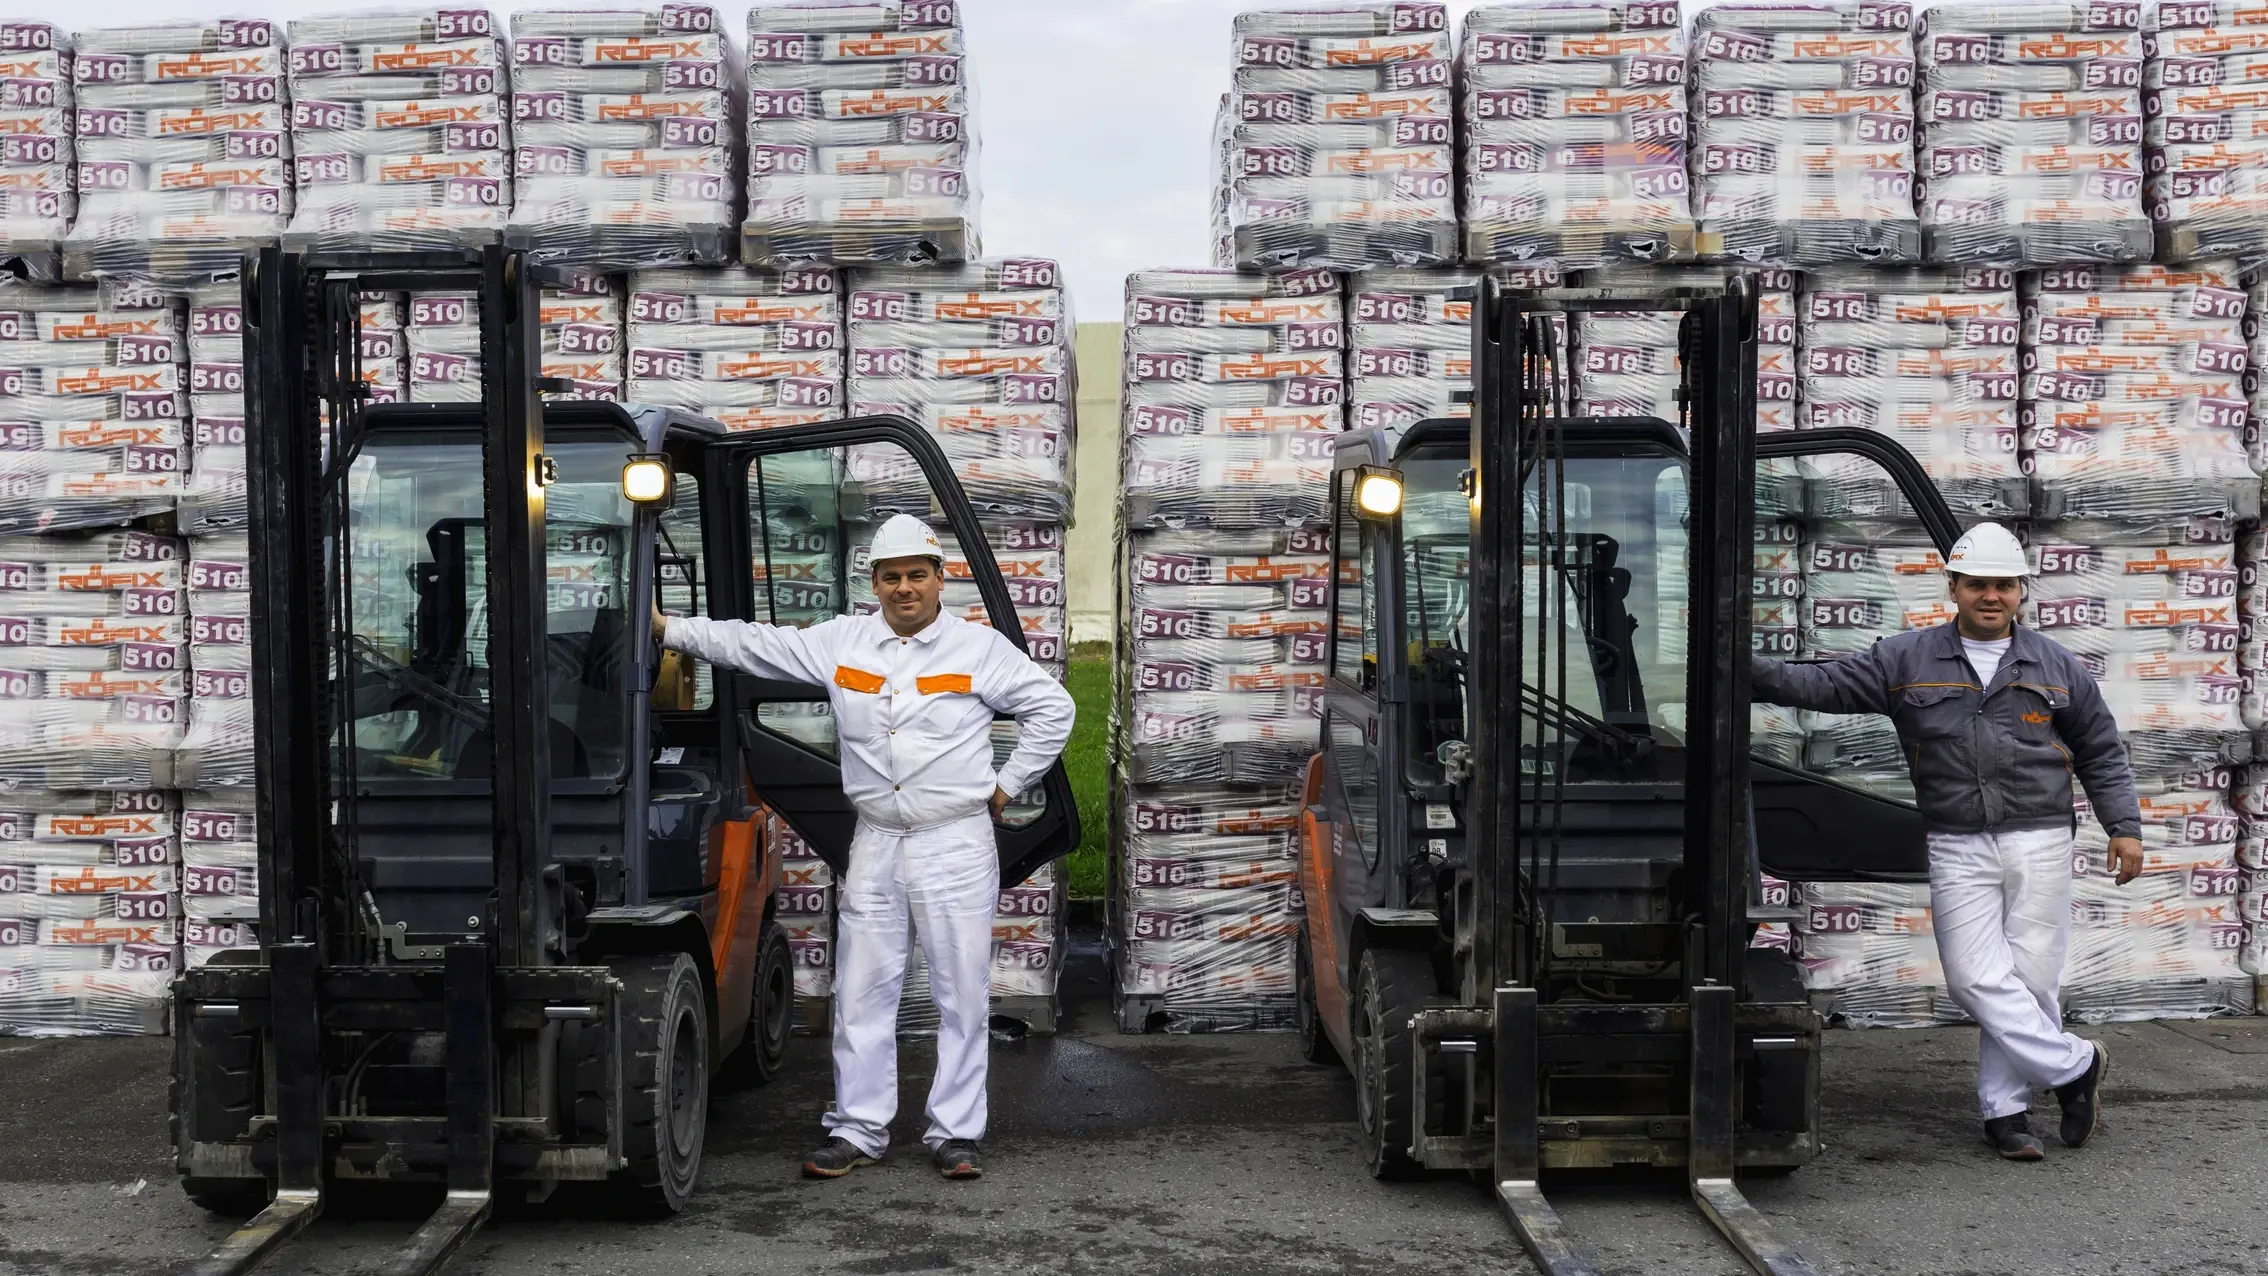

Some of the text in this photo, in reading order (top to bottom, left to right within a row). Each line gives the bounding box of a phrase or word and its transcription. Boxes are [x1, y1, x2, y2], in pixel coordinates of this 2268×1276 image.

[661, 7, 710, 31] 510
[902, 5, 952, 22] 510
[1396, 7, 1443, 29] 510
[1628, 6, 1677, 25] 510
[1860, 6, 1909, 28] 510
[2088, 7, 2138, 27] 510
[2160, 7, 2210, 26] 510
[220, 24, 269, 45] 510
[438, 15, 488, 35] 510
[1, 28, 49, 48] 510
[839, 33, 948, 57] RÖFIX
[374, 44, 478, 71] RÖFIX
[516, 44, 564, 62] 510
[596, 38, 704, 60] RÖFIX
[753, 41, 803, 59] 510
[1243, 43, 1292, 62] 510
[1478, 41, 1528, 61] 510
[1707, 37, 1757, 60] 510
[1935, 43, 1985, 62] 510
[158, 52, 264, 78] RÖFIX
[292, 50, 341, 69] 510
[78, 61, 125, 79] 510
[665, 66, 716, 86] 510
[906, 62, 956, 81] 510
[1397, 65, 1446, 88] 510
[1631, 61, 1681, 81] 510
[1861, 62, 1909, 86] 510
[2088, 66, 2137, 85] 510
[2164, 64, 2214, 85] 510
[226, 82, 274, 100] 510
[442, 72, 492, 92] 510
[515, 94, 563, 118] 510
[754, 96, 804, 115] 510
[1243, 100, 1292, 119] 510
[1478, 96, 1528, 116] 510
[1704, 97, 1756, 116] 510
[1935, 99, 1985, 118] 510
[80, 116, 127, 133] 510
[295, 107, 345, 127] 510
[665, 122, 714, 142] 510
[908, 119, 957, 139] 510
[1400, 122, 1447, 141] 510
[1860, 120, 1908, 141] 510
[2167, 122, 2216, 140] 510
[229, 138, 278, 156] 510
[448, 130, 498, 148] 510
[6, 142, 53, 160] 510
[1480, 152, 1530, 169] 510
[1706, 152, 1757, 169] 510
[755, 152, 805, 171] 510
[1244, 154, 1294, 174] 510
[81, 165, 128, 185] 510
[449, 183, 498, 203] 510
[782, 273, 831, 292] 510
[1002, 266, 1052, 286] 510
[1287, 270, 1334, 296] 510
[1963, 269, 2012, 288] 510
[2042, 272, 2090, 288] 510
[415, 304, 462, 320] 510
[633, 300, 682, 319] 510
[853, 299, 903, 318] 510
[1136, 303, 1186, 322] 510
[1359, 300, 1408, 319] 510
[1814, 300, 1862, 318] 510
[2195, 299, 2243, 317] 510
[193, 312, 240, 331] 510
[564, 334, 614, 352] 510
[782, 327, 832, 347] 510
[1003, 324, 1052, 344] 510
[1290, 328, 1338, 346] 510
[1967, 325, 2016, 345] 510
[2041, 325, 2090, 344] 510
[120, 343, 170, 362] 510
[1588, 352, 1638, 371] 510
[2199, 351, 2245, 371] 510
[415, 360, 465, 381] 510
[633, 356, 683, 375] 510
[856, 355, 904, 373] 510
[1137, 360, 1186, 378] 510
[1360, 355, 1408, 374] 510
[1812, 354, 1862, 373] 510
[194, 370, 241, 388] 510
[782, 384, 831, 403] 510
[1289, 383, 1338, 403] 510
[126, 401, 173, 418] 510
[2200, 406, 2245, 427] 510
[128, 449, 177, 469] 510
[1006, 528, 1054, 547] 510
[125, 539, 174, 560] 510
[1815, 549, 1863, 570] 510
[2042, 555, 2090, 573] 510
[192, 568, 241, 587] 510
[1142, 561, 1191, 582] 510
[126, 594, 173, 612] 510
[560, 590, 609, 608] 510
[1815, 606, 1863, 624] 510
[2040, 605, 2087, 625] 510
[194, 621, 244, 639] 510
[1142, 618, 1192, 636] 510
[125, 649, 172, 668] 510
[198, 676, 246, 693] 510
[1142, 671, 1191, 689] 510
[126, 701, 173, 721] 510
[116, 791, 163, 811] 510
[51, 814, 156, 835] RÖFIX
[186, 821, 233, 837] 510
[2187, 822, 2234, 841] 510
[118, 845, 166, 862] 510
[51, 868, 156, 892] RÖFIX
[187, 876, 234, 892] 510
[2192, 876, 2237, 896] 510
[120, 900, 165, 917] 510
[999, 895, 1048, 914] 510
[1812, 912, 1859, 929] 510
